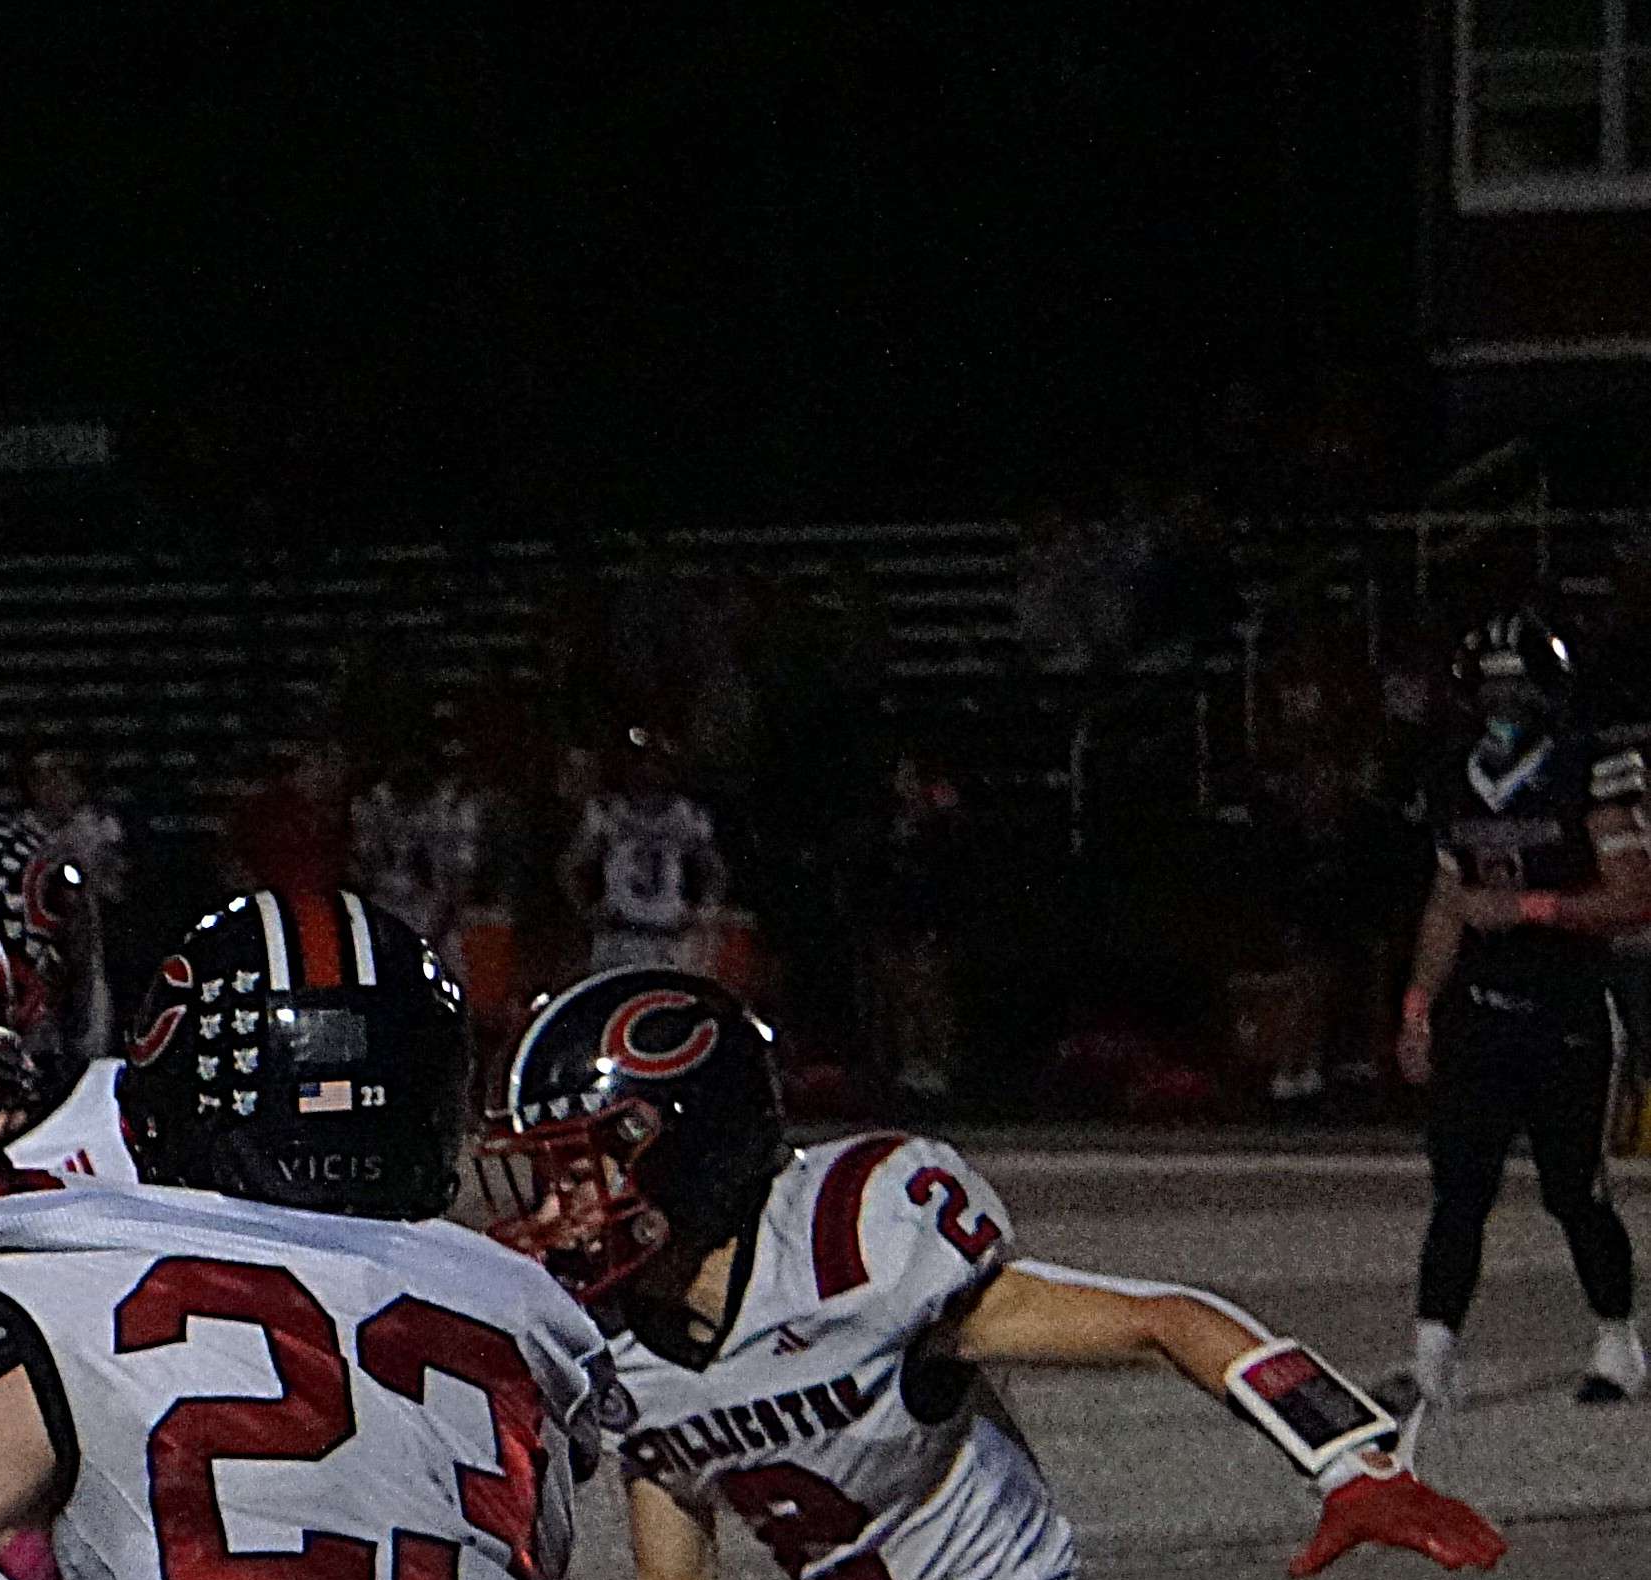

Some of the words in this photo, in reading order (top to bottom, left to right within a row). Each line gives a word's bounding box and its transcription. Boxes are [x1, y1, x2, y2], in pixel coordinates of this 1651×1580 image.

[359, 1084, 387, 1107] 23
[276, 1153, 383, 1183] VICIS
[905, 1166, 1002, 1264] 2
